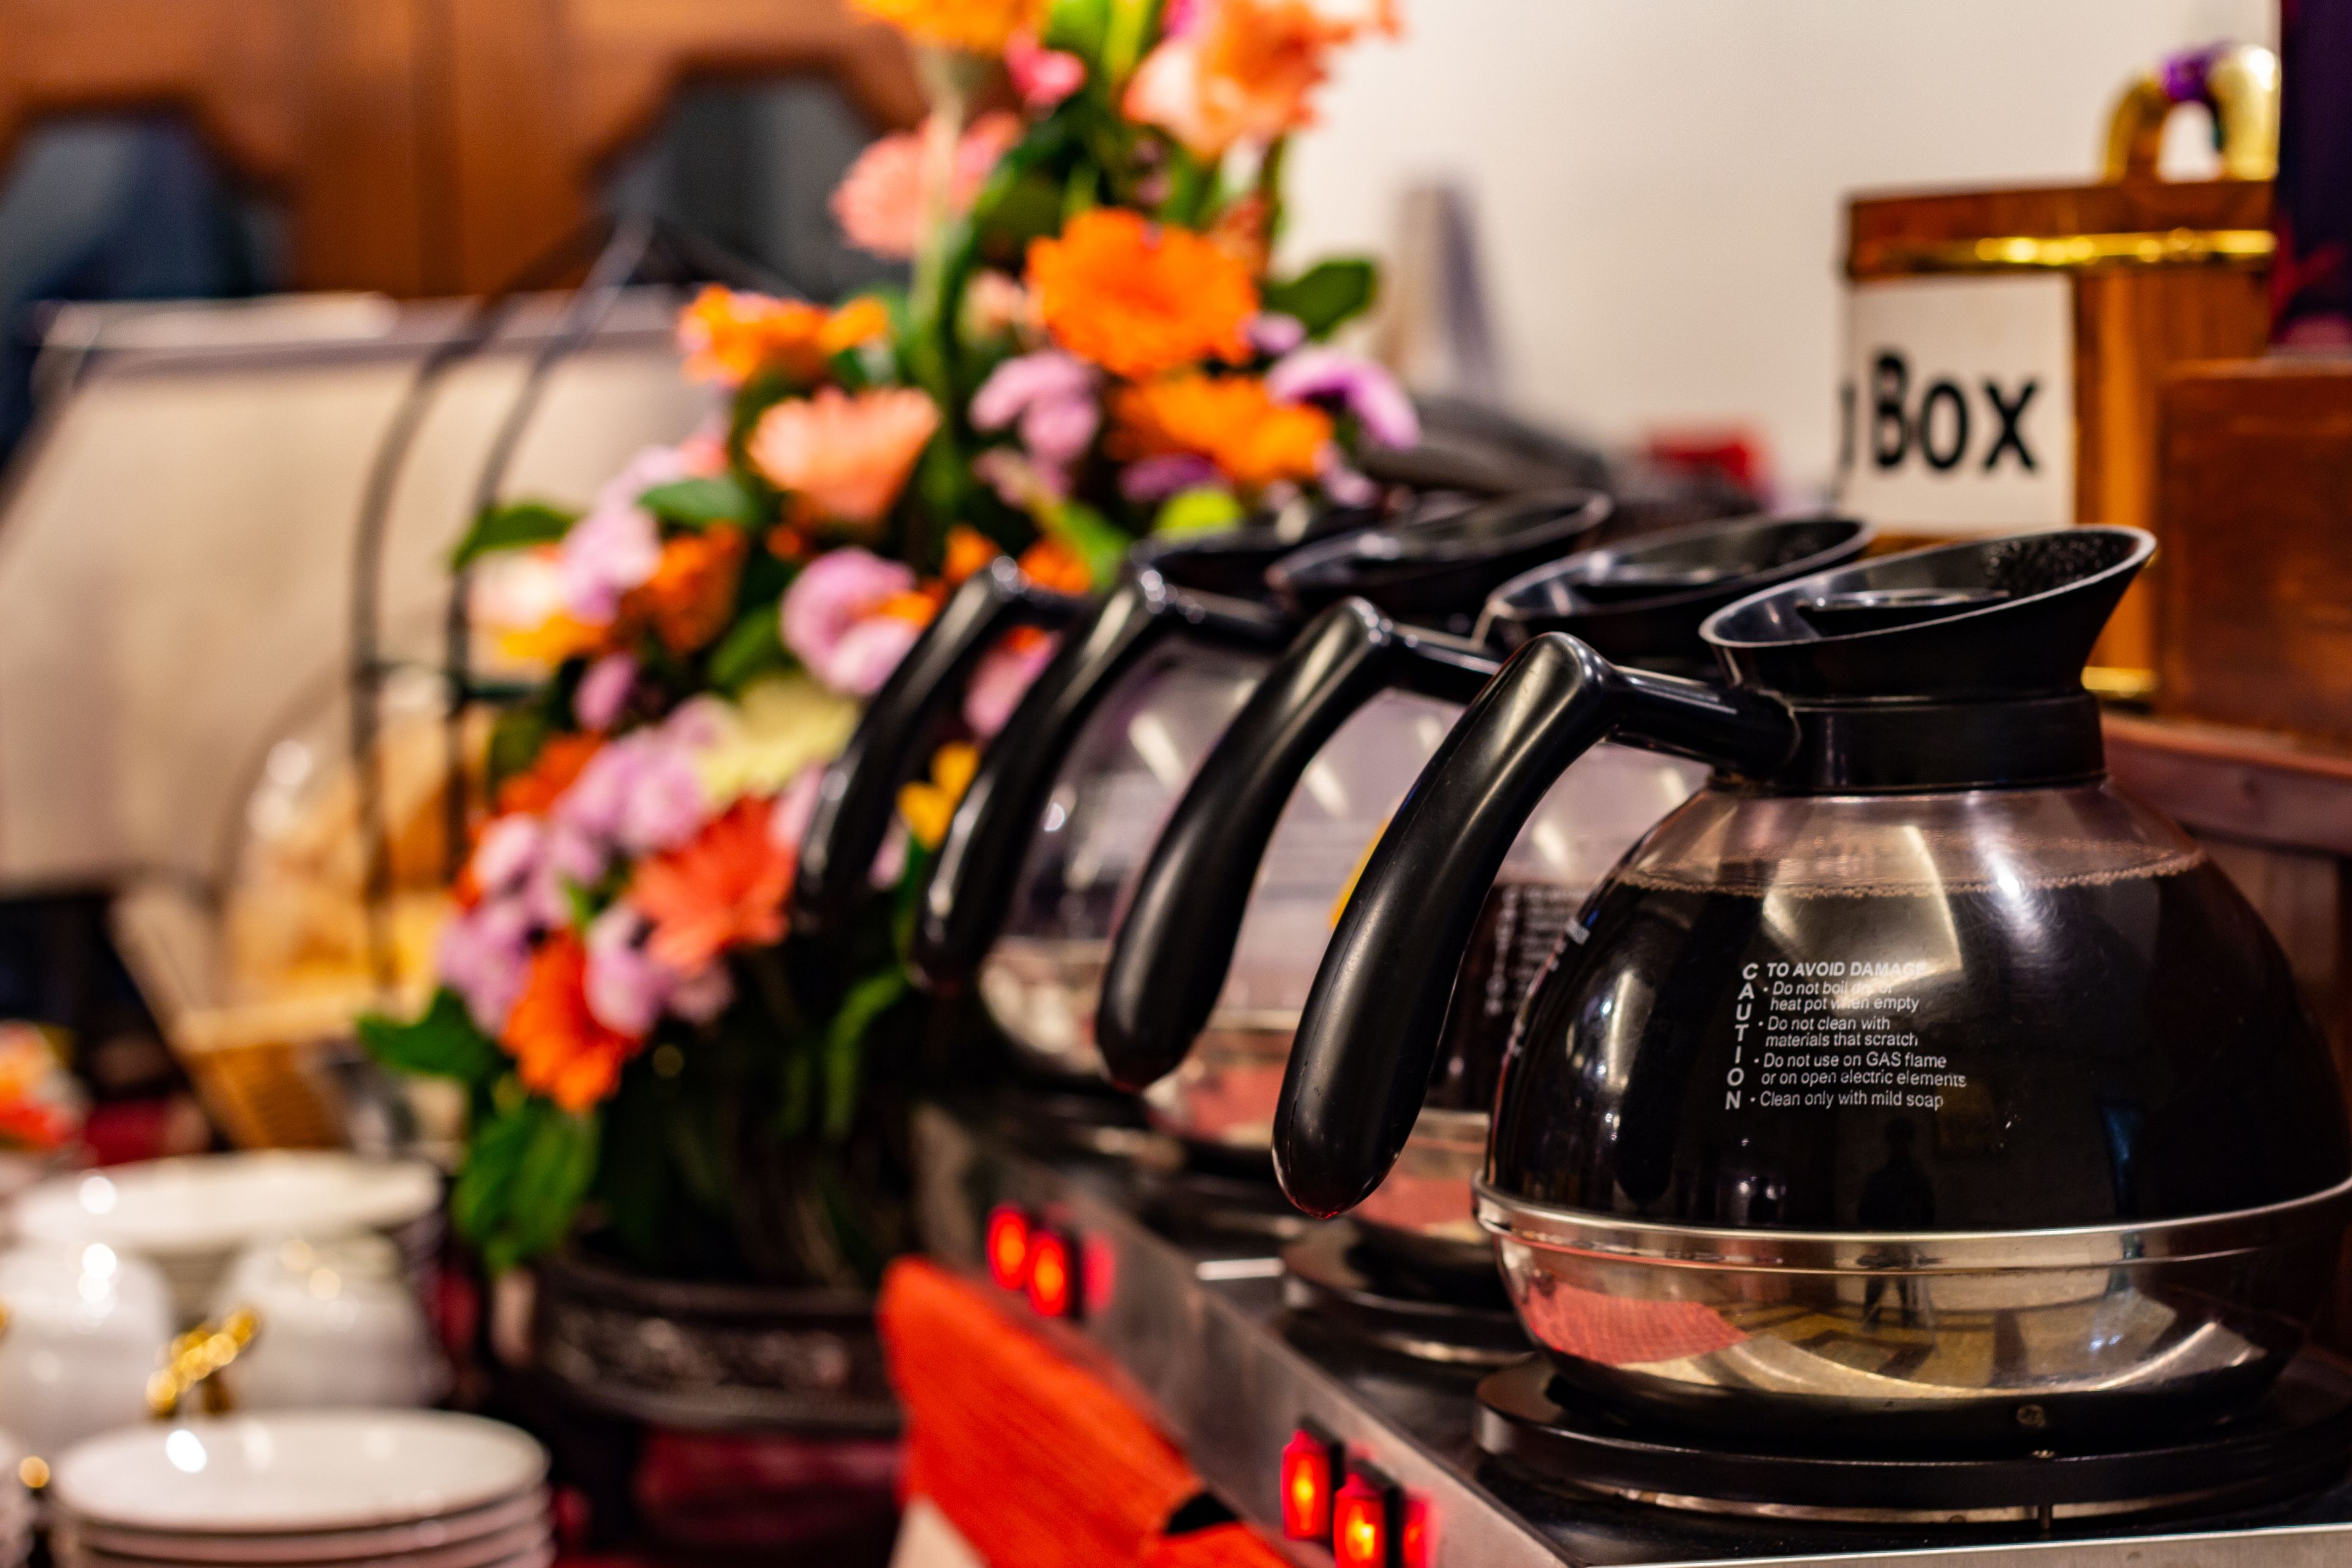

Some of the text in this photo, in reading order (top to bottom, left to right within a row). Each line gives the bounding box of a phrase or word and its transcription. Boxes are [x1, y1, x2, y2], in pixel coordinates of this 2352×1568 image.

[1874, 352, 2039, 473] Box
[1767, 962, 1928, 977] TO AVOID DAMAGE
[1773, 981, 1793, 995] Do
[1796, 982, 1819, 995] not
[1823, 981, 1847, 995] boil
[1879, 982, 1893, 993] or
[1770, 997, 1920, 1014] heat pot when empty
[1768, 1017, 1890, 1030] Do not clean with
[1765, 1033, 1918, 1047] materials that scratch
[1763, 1052, 1947, 1068] Do not use on GAS flame
[1762, 1069, 1967, 1088] or on open electric elements
[1760, 1091, 1943, 1112] Clean only with mild soap
